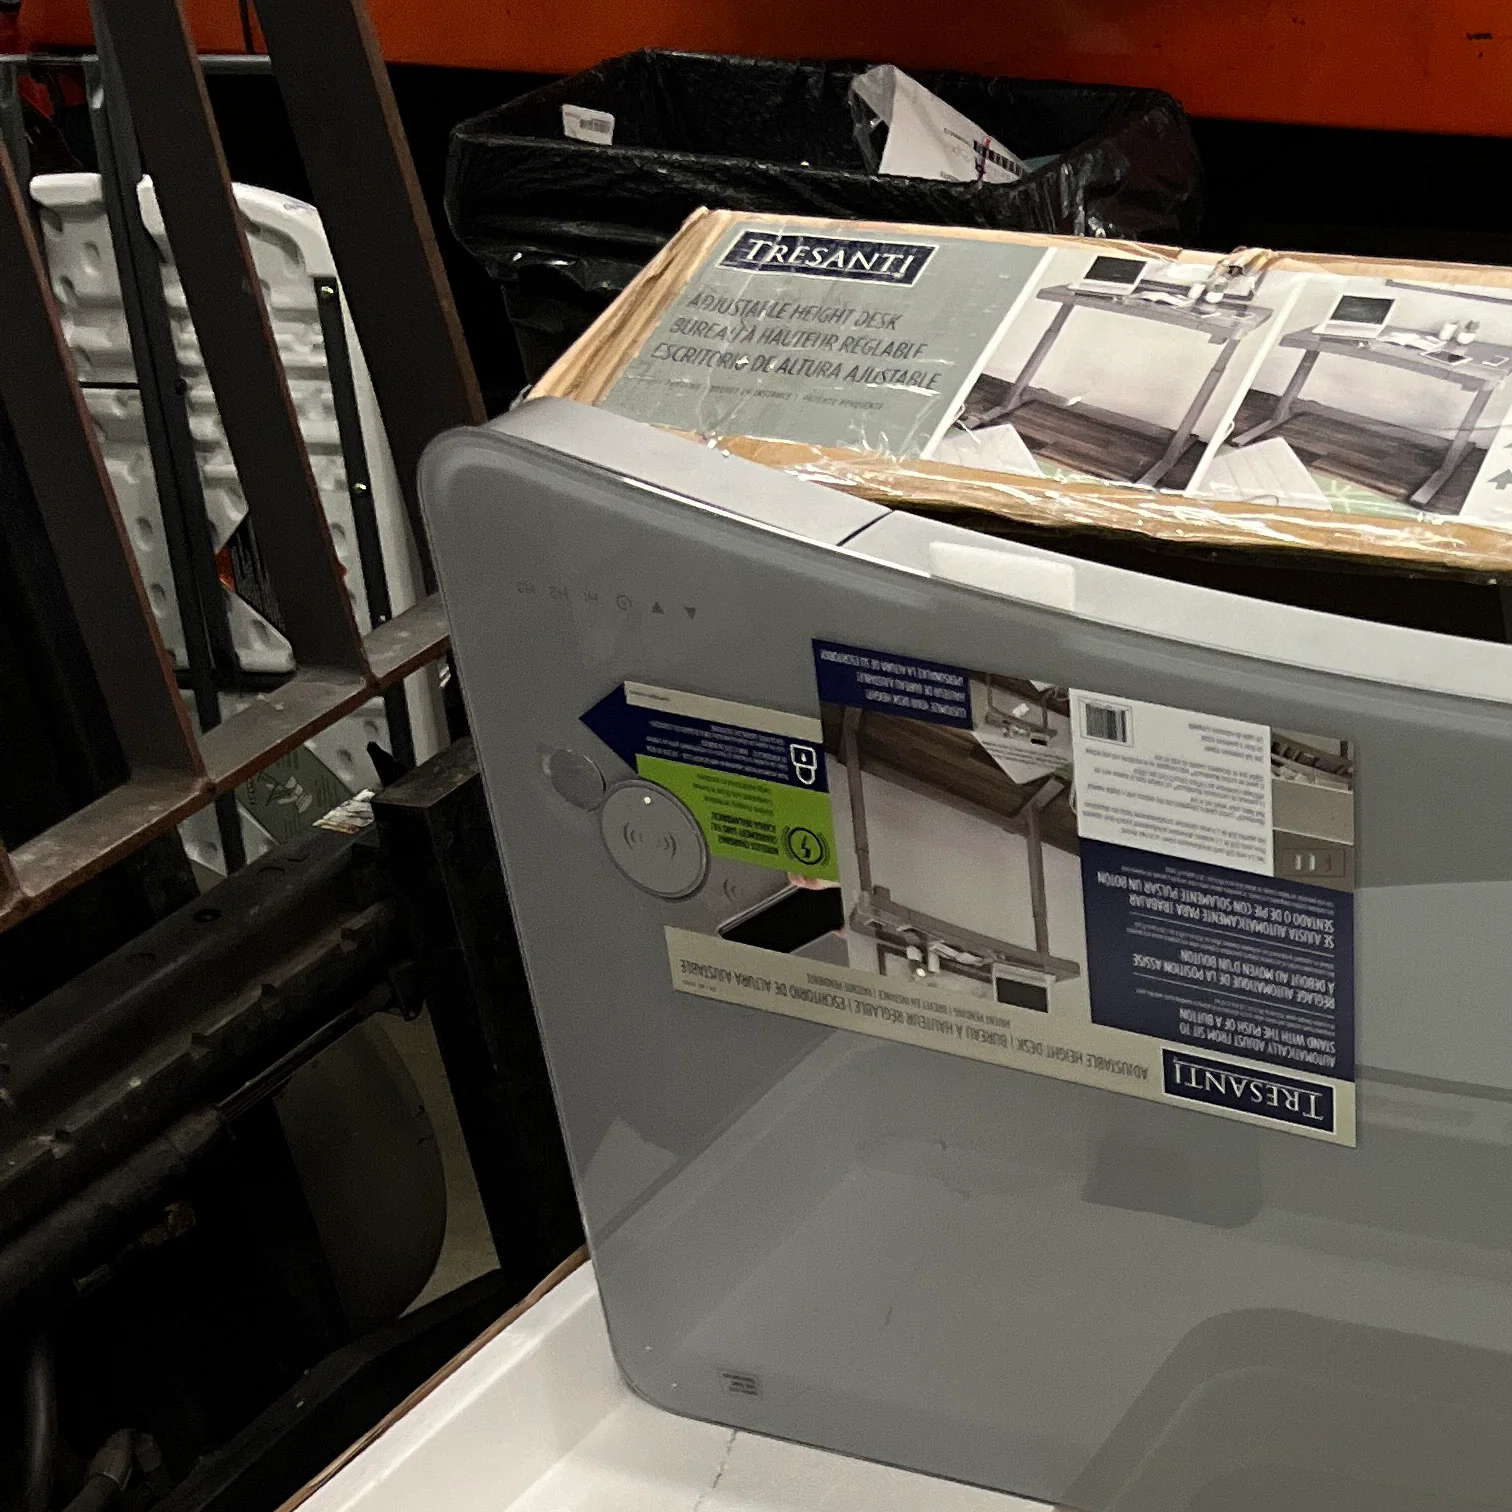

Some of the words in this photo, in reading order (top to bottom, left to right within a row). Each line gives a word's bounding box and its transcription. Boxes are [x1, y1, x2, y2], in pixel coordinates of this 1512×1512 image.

[744, 239, 915, 278] TRESANTI
[686, 291, 791, 321] ADJUSTABLE
[790, 303, 856, 326] HEIGHT
[854, 310, 904, 331] DESK
[759, 325, 840, 351] HAUTEUR
[748, 353, 778, 374] DE
[776, 355, 843, 381] ALTURA
[843, 363, 943, 391] AJUSTABLE
[1175, 903, 1201, 921] PARA
[1233, 900, 1253, 916] CON
[1269, 908, 1282, 922] DE
[1322, 934, 1335, 949] SE
[1132, 953, 1162, 972] ASSISE
[1163, 960, 1204, 981] POSITION
[733, 972, 772, 994] ALTURA
[1205, 970, 1218, 982] LA
[1220, 973, 1231, 986] DE
[774, 981, 788, 997] DE
[904, 1012, 953, 1035] HAUTEUR
[1180, 1022, 1191, 1034] TO
[1215, 1016, 1223, 1028] A
[1224, 1018, 1236, 1032] OF
[1237, 1021, 1261, 1037] PUSH
[964, 1028, 1011, 1052] BUREAU
[1208, 1028, 1233, 1044] FROM
[1262, 1025, 1280, 1041] THE
[1280, 1030, 1306, 1047] WITH
[1016, 1037, 1044, 1058] DESK
[1233, 1034, 1266, 1052] ADJUST
[1306, 1035, 1336, 1053] STAND
[1045, 1042, 1084, 1067] HEIGHT
[1268, 1042, 1336, 1068] AUTOMATICALLY
[1085, 1053, 1149, 1082] ADJUSTABLE
[1173, 1060, 1324, 1120] TRESANTI
